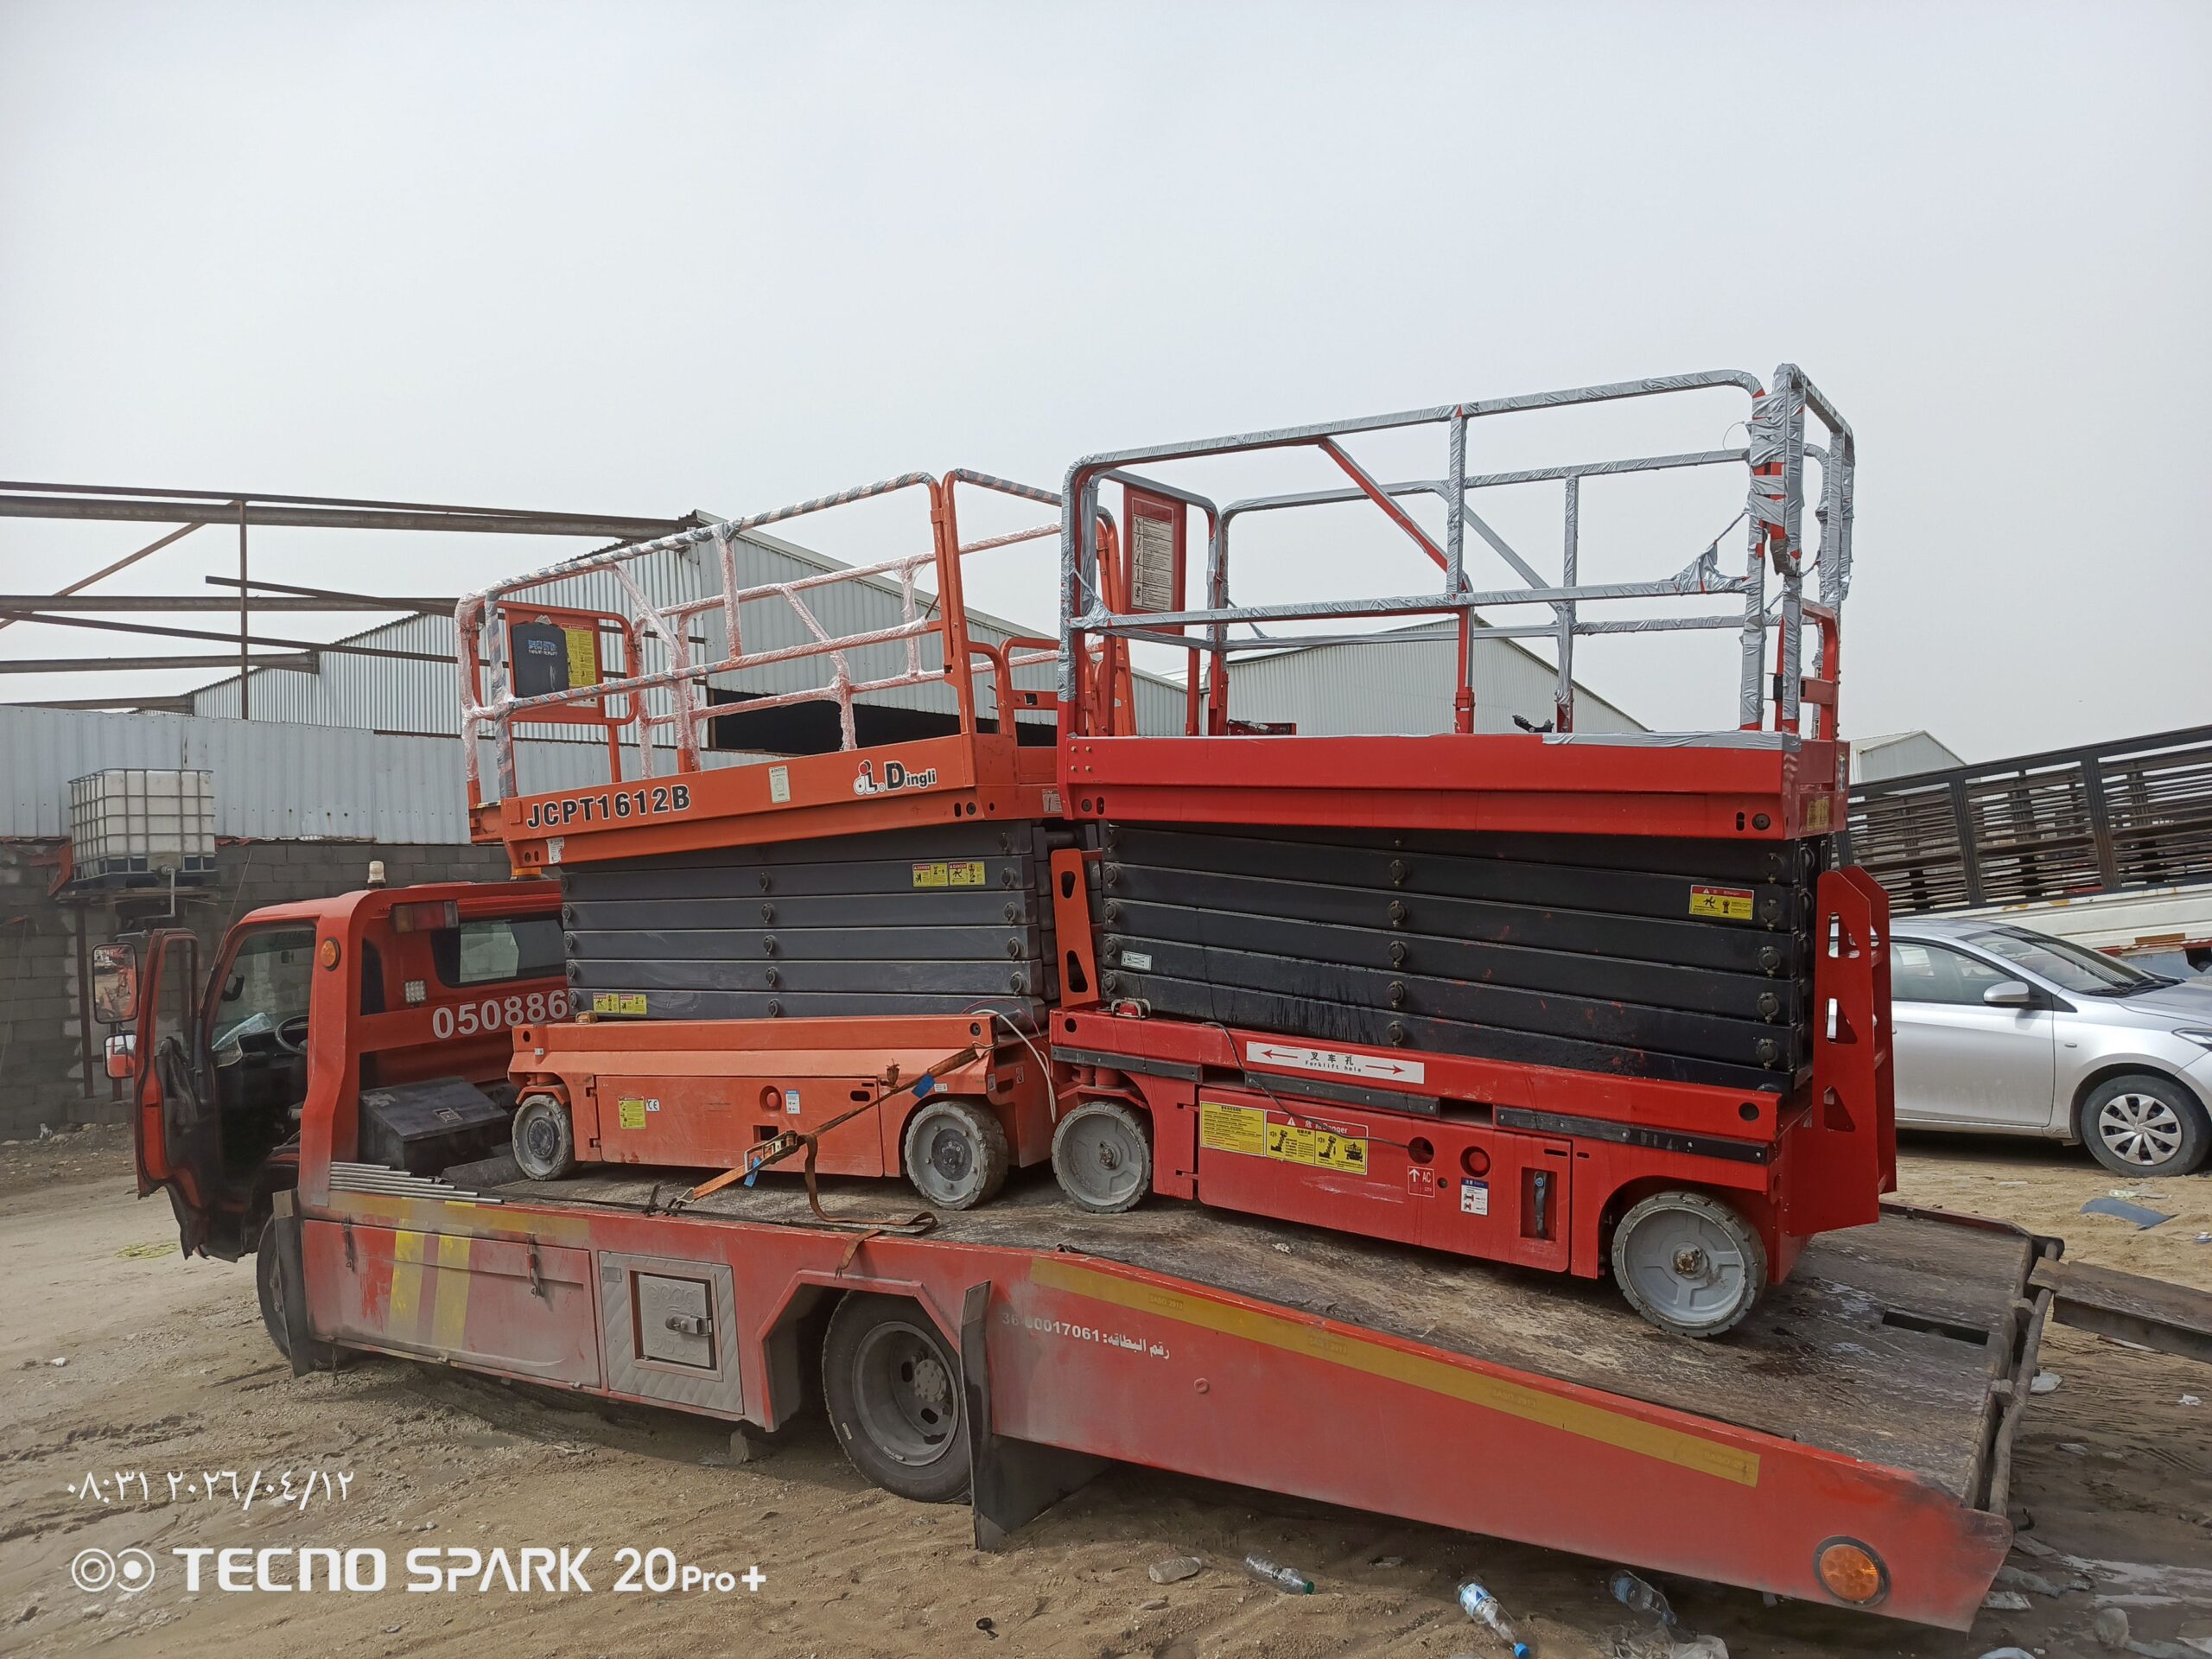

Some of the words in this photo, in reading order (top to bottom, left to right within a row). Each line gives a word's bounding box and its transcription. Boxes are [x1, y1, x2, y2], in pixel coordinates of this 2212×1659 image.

[885, 761, 937, 790] Dingli
[526, 784, 691, 830] JCPT1612B
[1305, 1060, 1339, 1070] Forklift
[1422, 1172, 1432, 1183] AC
[1149, 1341, 1170, 1359] رقم
